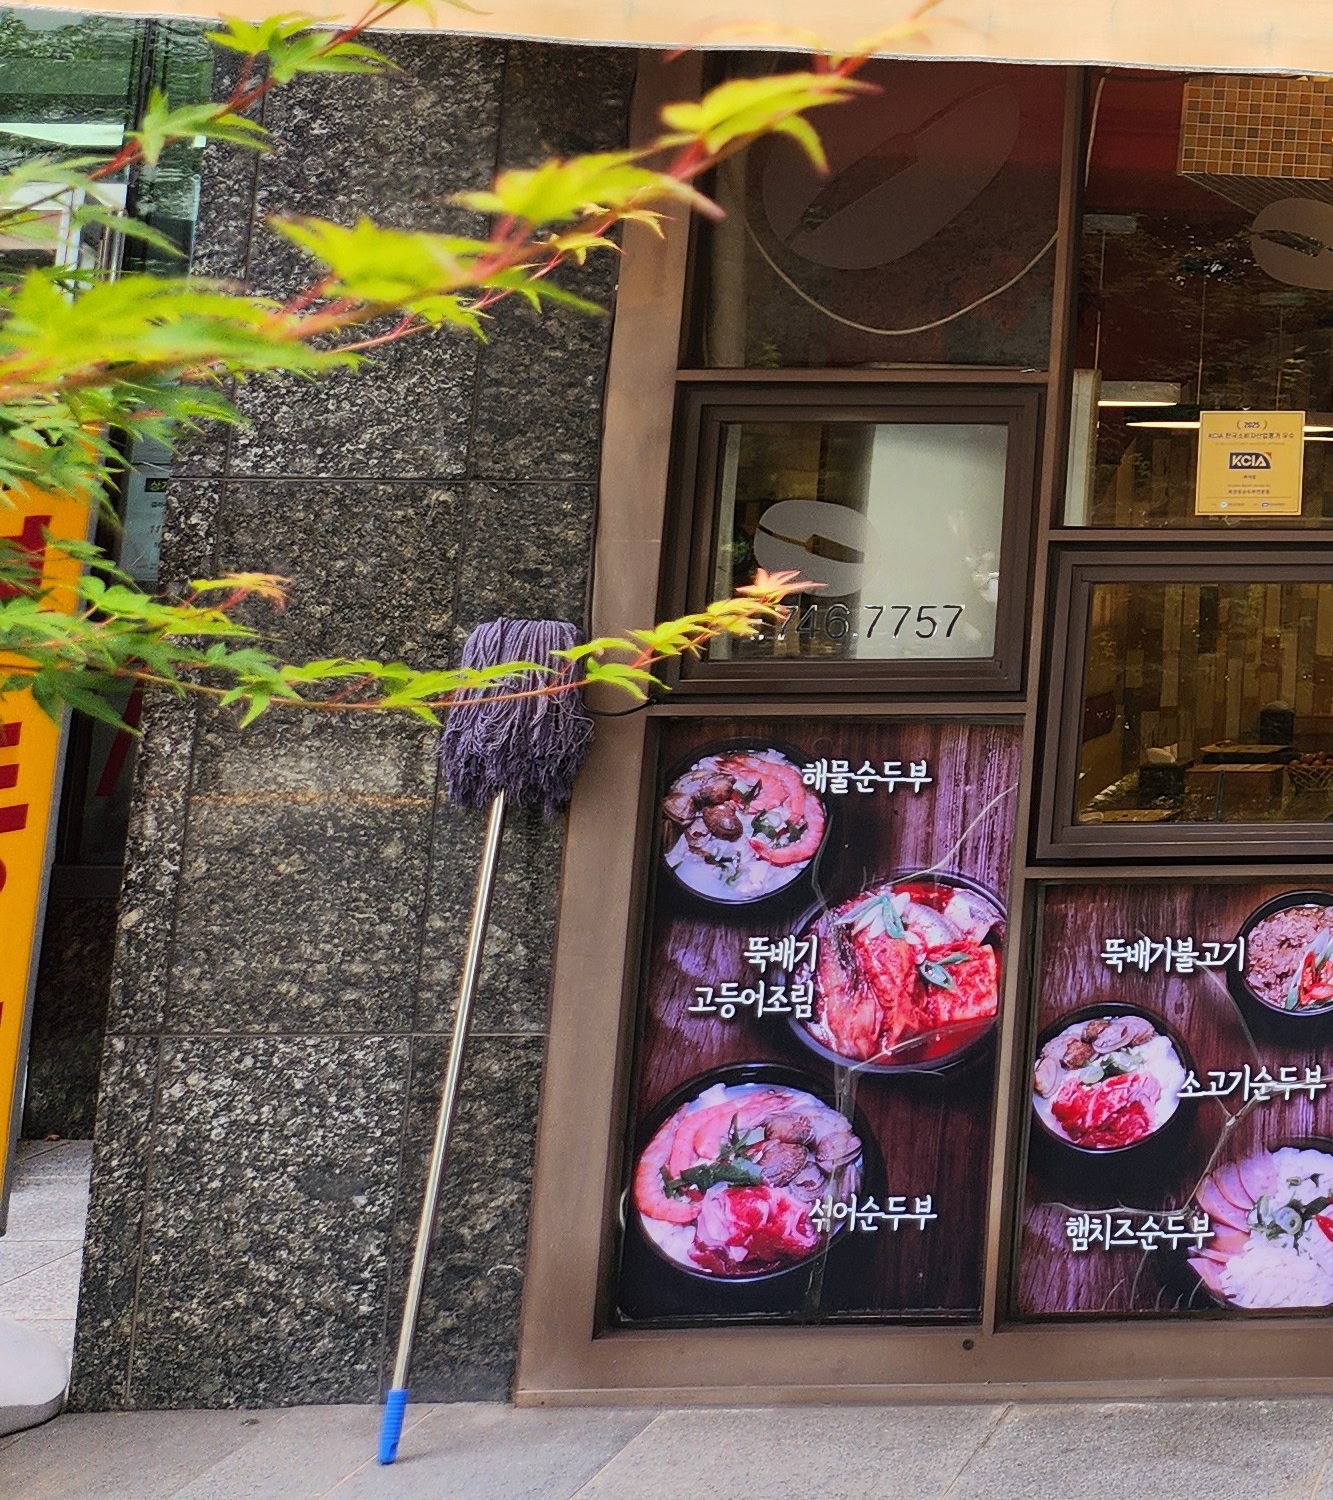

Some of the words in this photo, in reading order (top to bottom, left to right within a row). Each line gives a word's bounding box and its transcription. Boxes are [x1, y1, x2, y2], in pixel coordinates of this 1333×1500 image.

[1231, 454, 1267, 467] KCIA
[801, 759, 933, 795] 해물순두부
[743, 935, 818, 973] 뚝배기
[1100, 936, 1246, 975] 뚝배기불고기
[688, 982, 815, 1019] 고등어조림
[1175, 1063, 1327, 1100] 소고기순두부
[808, 1193, 938, 1232] 섞어순두부
[1065, 1213, 1215, 1251] 햄치즈순두부
